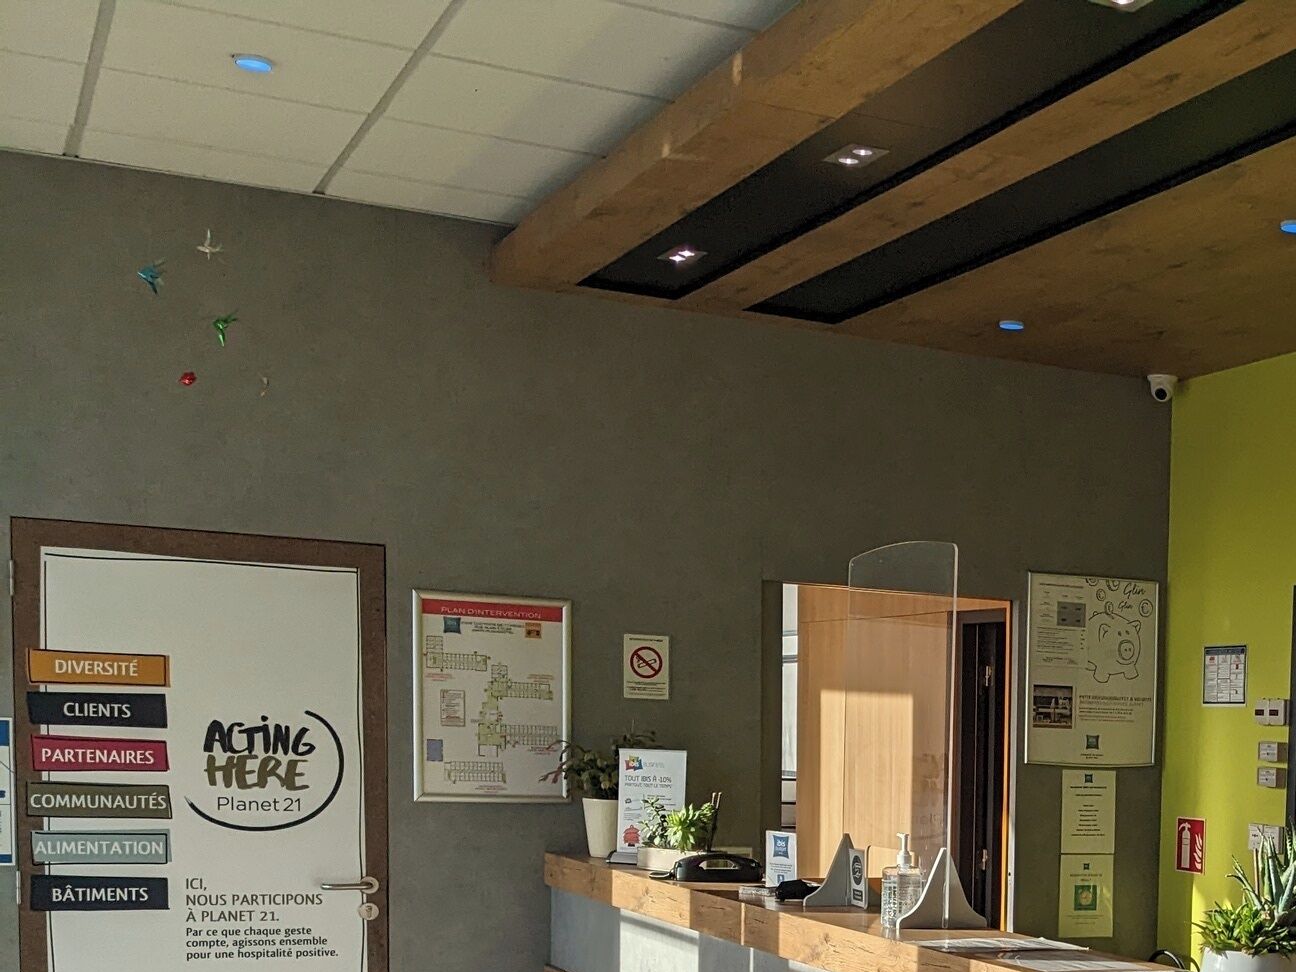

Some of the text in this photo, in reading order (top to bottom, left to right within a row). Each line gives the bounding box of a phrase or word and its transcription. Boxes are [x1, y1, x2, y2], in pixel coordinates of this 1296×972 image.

[441, 606, 466, 614] PLAN
[55, 659, 138, 677] DIVERSITÉ
[63, 702, 131, 718] CLIENTS
[41, 749, 154, 765] PARTENAIRES
[204, 754, 309, 791] HERE
[30, 793, 167, 810] COMMUNAUTÉS
[217, 797, 301, 811] Planet 21
[34, 841, 164, 855] ALIMENTATION
[186, 878, 207, 891] ICI,
[52, 886, 148, 902] BÂTIMENTS
[186, 894, 323, 906] NOUS PARTICIPONS
[186, 908, 279, 922] À PLANET 21.
[186, 928, 202, 936] Par
[222, 928, 240, 938] que
[244, 927, 281, 938] chaque
[285, 928, 312, 937] geste
[186, 937, 327, 949] compte, agissons ensemble
[187, 952, 211, 961] pour
[238, 949, 292, 960] hospitalité
[296, 948, 338, 959] positive.
